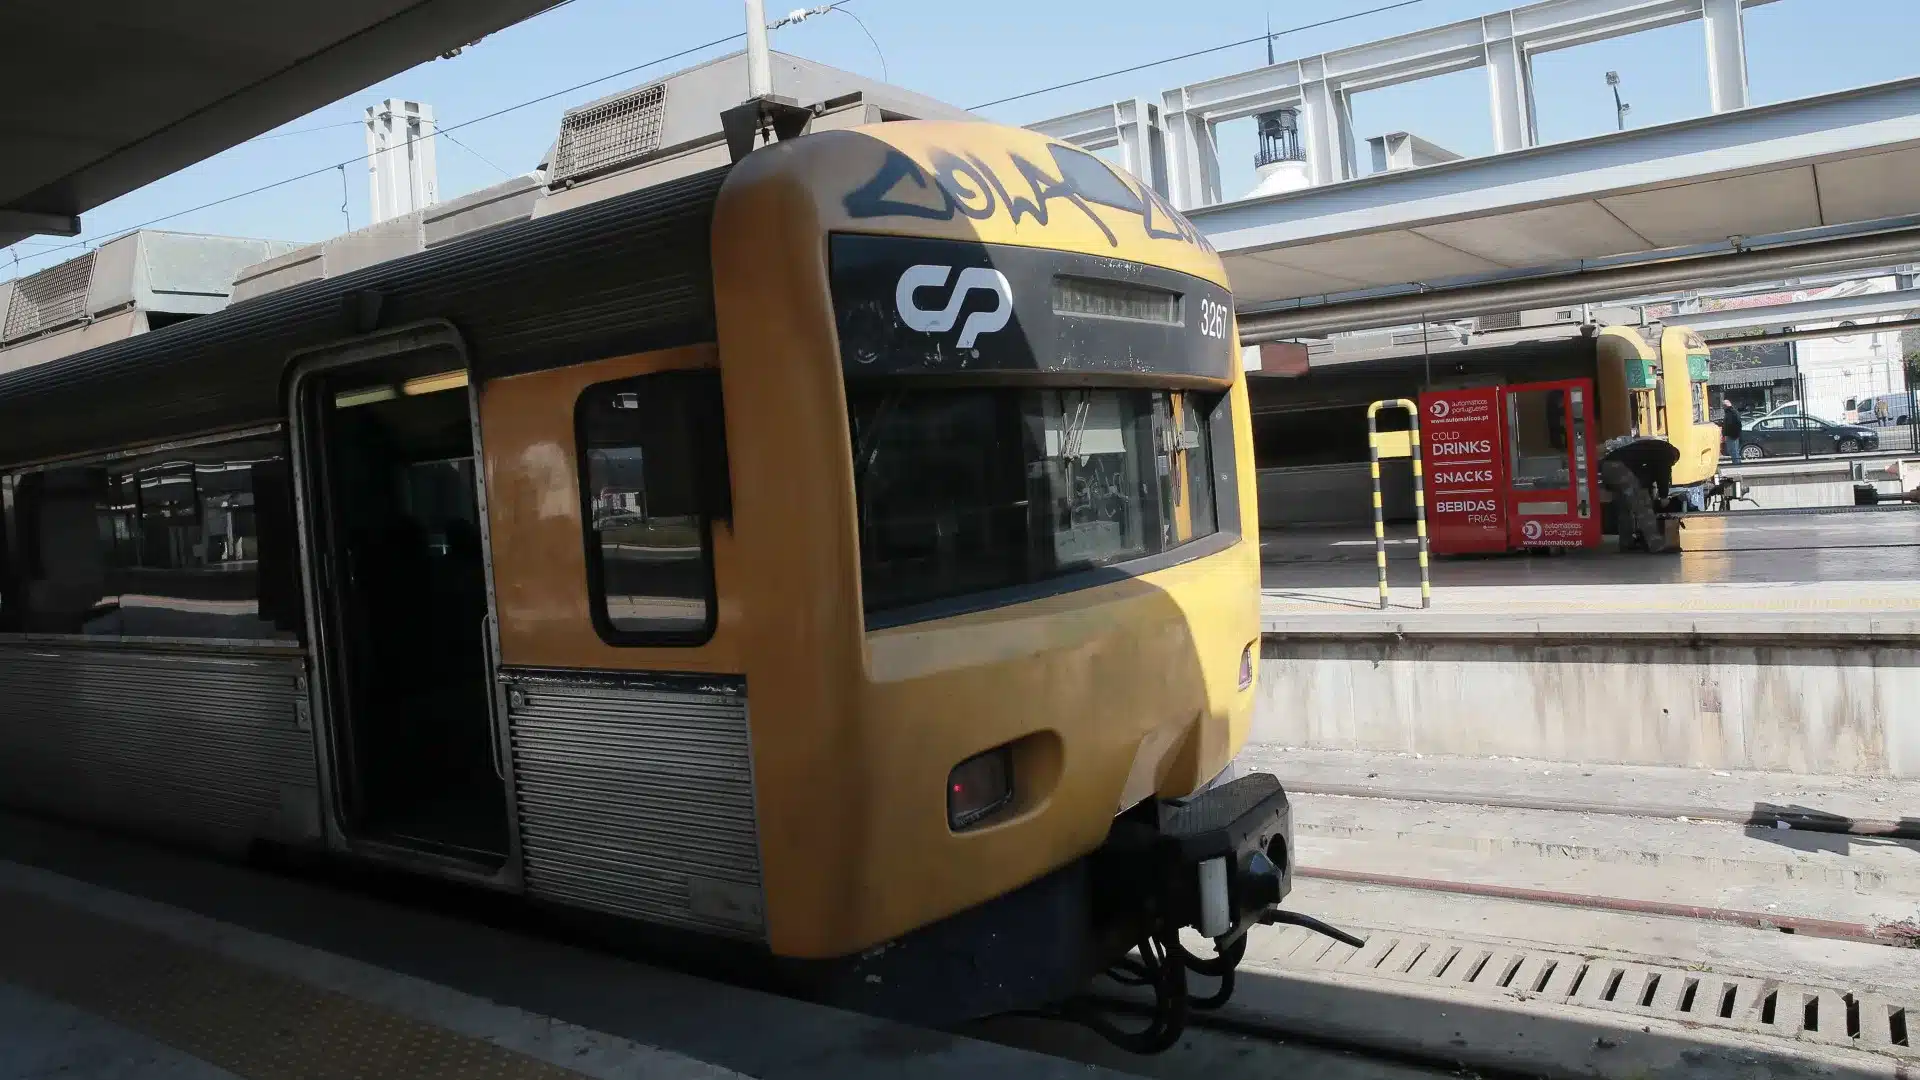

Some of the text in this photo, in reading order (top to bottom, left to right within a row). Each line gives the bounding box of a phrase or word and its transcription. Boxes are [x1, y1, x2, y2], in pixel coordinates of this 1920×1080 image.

[896, 264, 1013, 349] CP
[1201, 298, 1228, 339] 3267
[1451, 405, 1488, 414] portugueses
[1430, 414, 1489, 424] www.automaticos.pt
[1431, 431, 1460, 441] COLD
[1432, 440, 1491, 456] DRINKS
[1434, 470, 1493, 484] SNACKS
[1436, 499, 1496, 513] BEBIDAS
[1468, 513, 1497, 523] FRIAS
[1523, 539, 1583, 547] www.automaticos.pt
